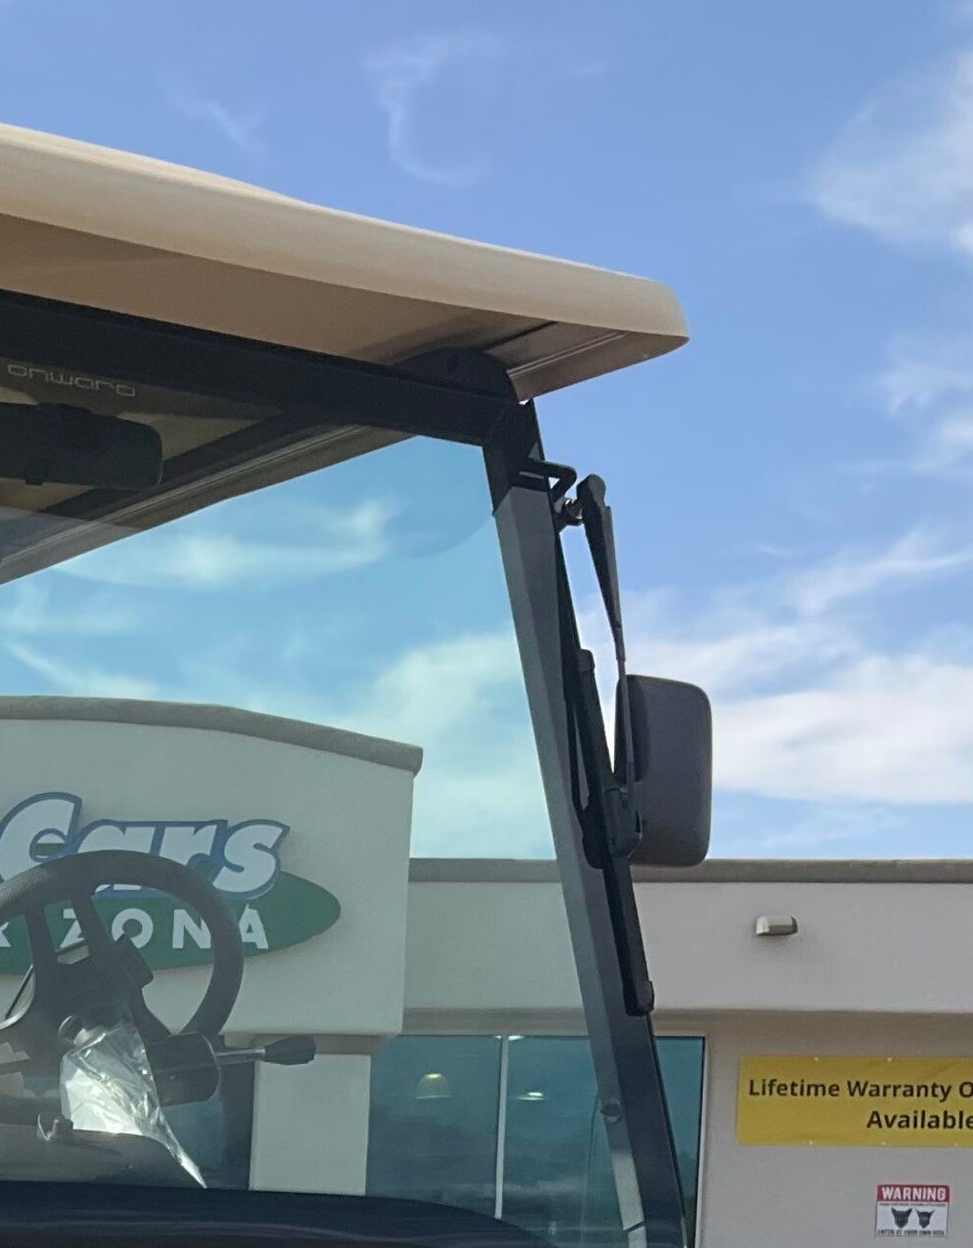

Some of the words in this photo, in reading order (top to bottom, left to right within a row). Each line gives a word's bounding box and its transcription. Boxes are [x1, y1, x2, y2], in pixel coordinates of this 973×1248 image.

[748, 1078, 841, 1098] Lifetime
[846, 1080, 952, 1103] Warranty
[865, 1109, 973, 1130] Available
[881, 1186, 947, 1201] WARNING
